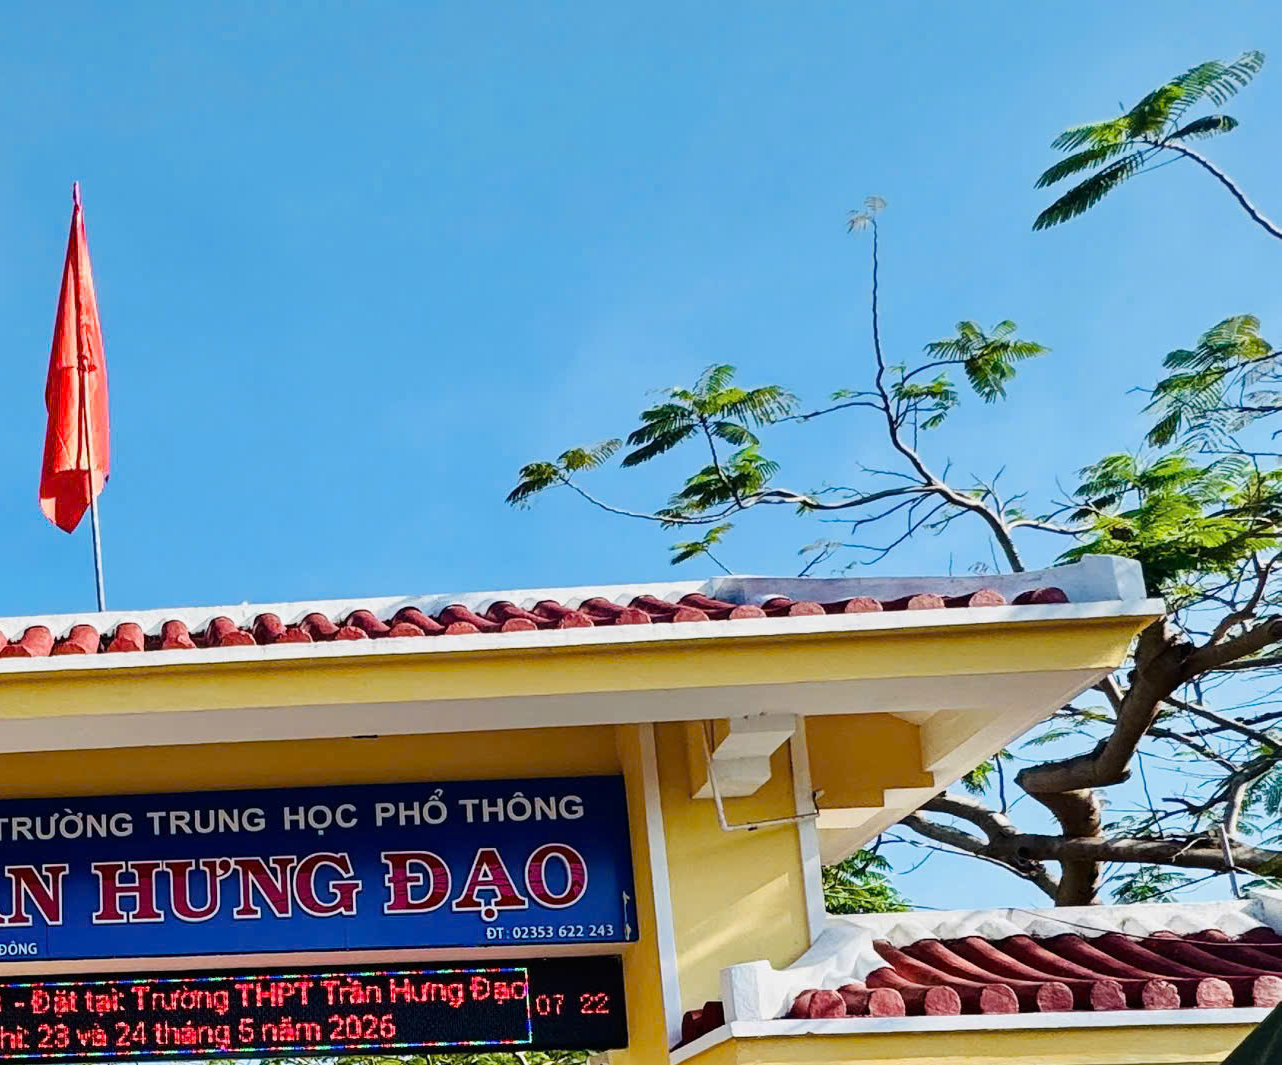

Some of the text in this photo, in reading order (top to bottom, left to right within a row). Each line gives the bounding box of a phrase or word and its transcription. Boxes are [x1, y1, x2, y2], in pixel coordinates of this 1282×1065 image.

[146, 807, 266, 837] TRUNG
[283, 803, 358, 836] HỌC
[375, 788, 447, 828] PHỔ
[458, 793, 584, 824] THÔNG
[91, 851, 362, 926] HƯNG
[381, 842, 588, 922] ĐẠO
[512, 926, 554, 939] 02353
[558, 925, 584, 937] 622
[588, 924, 614, 937] 243
[31, 988, 78, 1018] Đặt
[131, 985, 230, 1017] Trường
[234, 981, 313, 1008] THPT
[320, 977, 382, 1005] Trần
[389, 978, 463, 1008] Hưng
[470, 976, 527, 1005] Đạo
[535, 992, 610, 1016] 07 22
[37, 1023, 70, 1048] 23
[76, 1023, 108, 1047] và
[114, 1020, 148, 1047] 24
[152, 1019, 231, 1050] tháng
[238, 1017, 256, 1043] 5
[261, 1015, 322, 1043] năm
